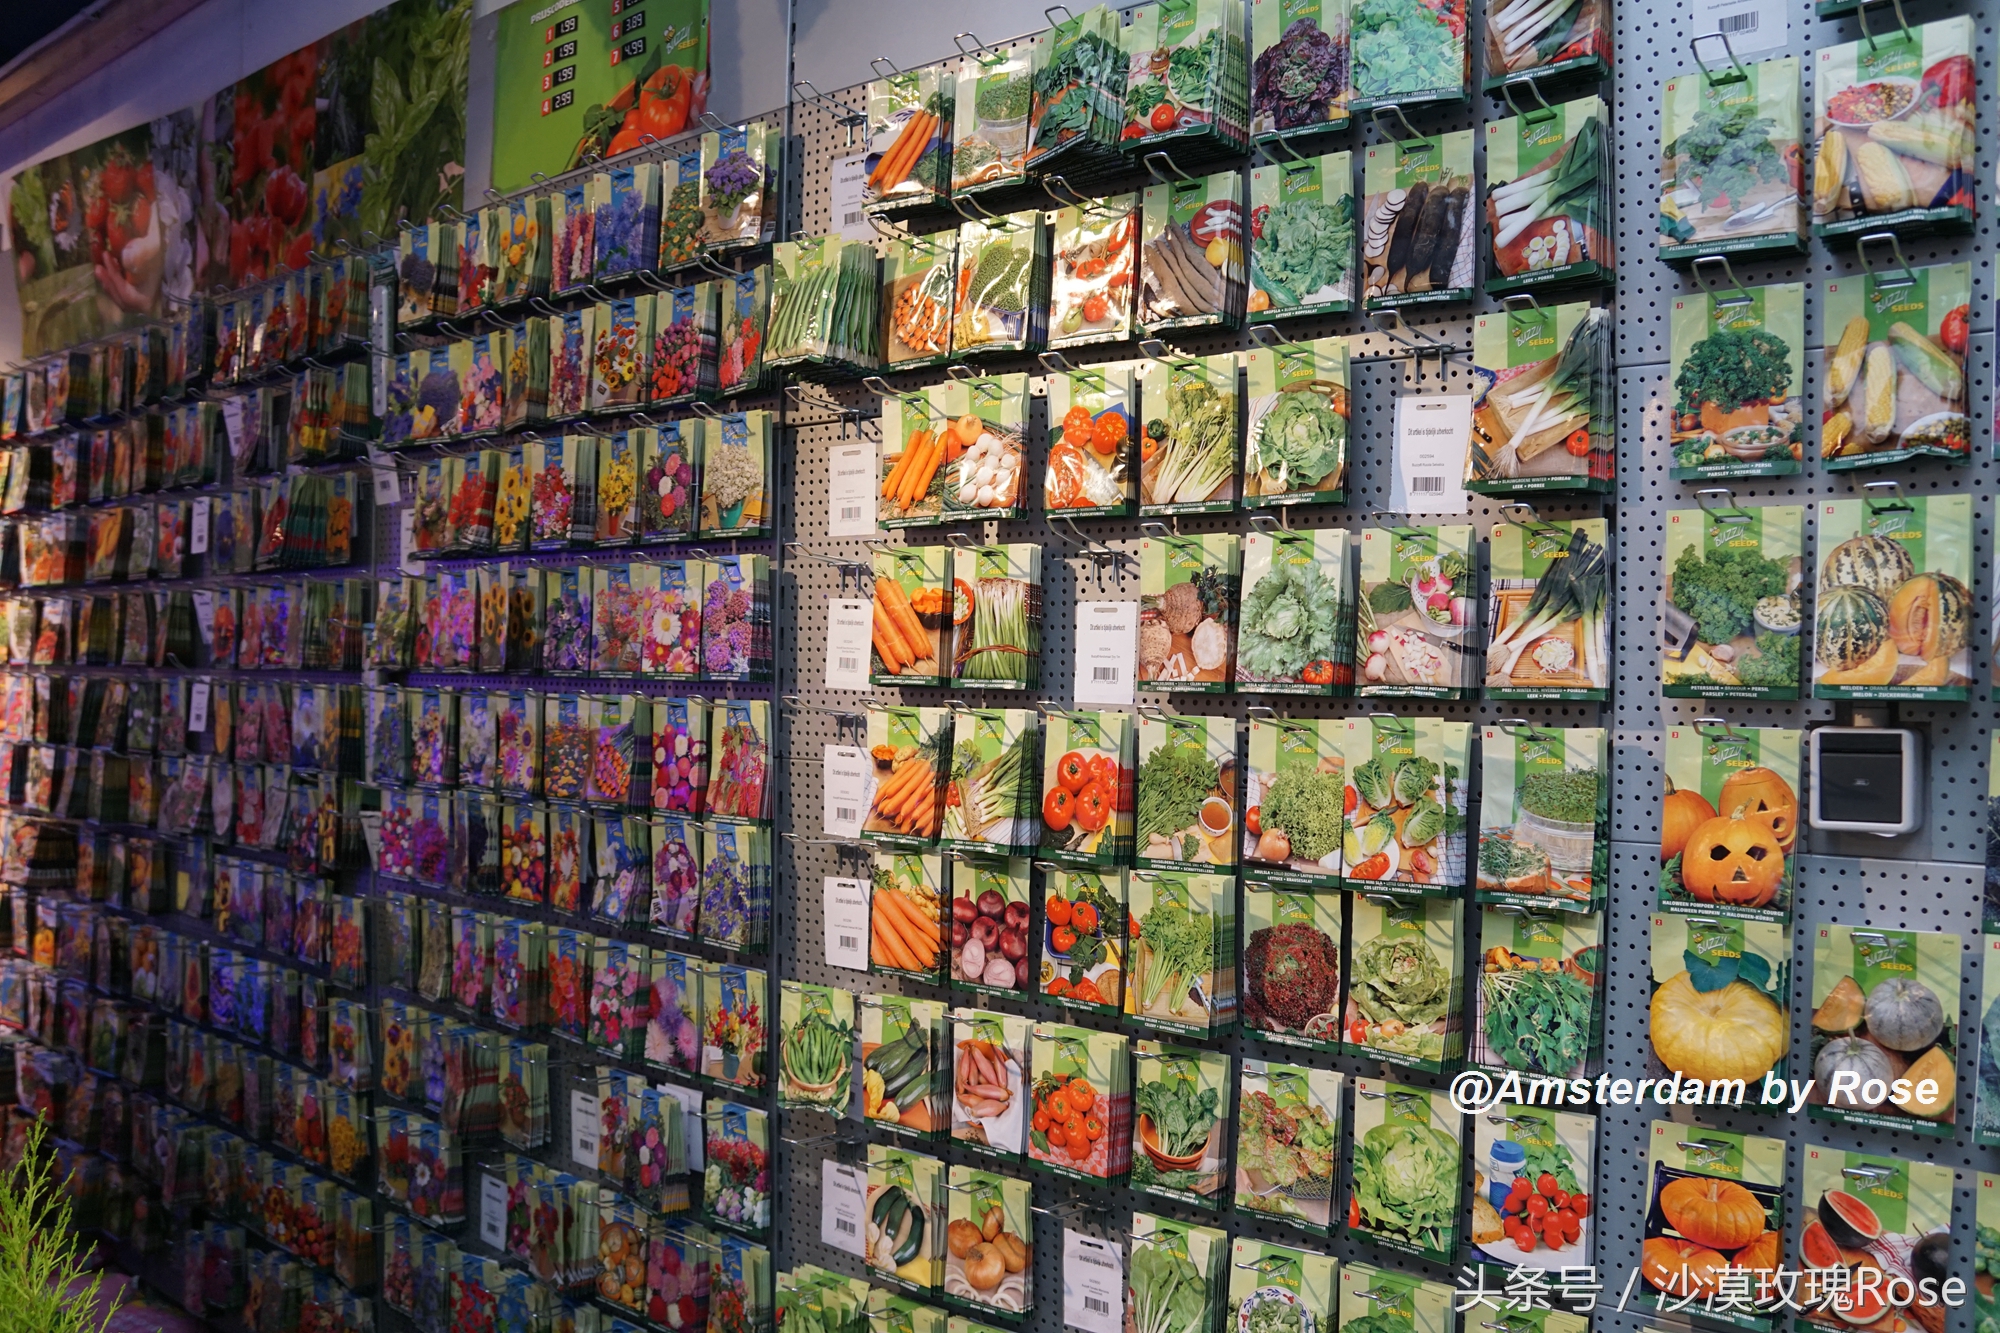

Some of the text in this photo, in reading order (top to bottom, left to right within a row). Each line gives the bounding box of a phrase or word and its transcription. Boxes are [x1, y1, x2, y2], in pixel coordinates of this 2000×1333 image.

[1297, 5, 1319, 15] SEEDS
[1174, 19, 1195, 29] SEEDS
[612, 25, 619, 38] 6
[612, 39, 644, 62] 7 4.99
[545, 53, 551, 65] 2
[543, 77, 550, 89] 3
[542, 92, 572, 113] 4 2.99
[1538, 134, 1562, 146] SEEDS
[1416, 164, 1440, 173] SEEDS
[1298, 184, 1320, 194] SEEDS
[1185, 201, 1204, 211] SEEDS
[1891, 302, 1924, 313] SEEDS
[1516, 325, 1542, 347] BUZZY
[1529, 337, 1554, 346] SEEDS
[1293, 369, 1313, 378] SEEDS
[1714, 526, 1746, 547] BUZZY
[1889, 531, 1922, 539] SEEDS
[1729, 540, 1758, 548] SEEDS
[1289, 557, 1311, 565] SEEDS
[1537, 757, 1562, 765] SEEDS
[1711, 950, 1741, 959] SEEDS
[1880, 962, 1913, 971] SEEDS
[1869, 1118, 1913, 1130] ZUCKERMELONE
[1916, 1119, 1937, 1127] MELON
[1527, 1137, 1552, 1147] SEEDS
[1710, 1163, 1739, 1174] SEEDS
[1871, 1187, 1903, 1199] SEEDS
